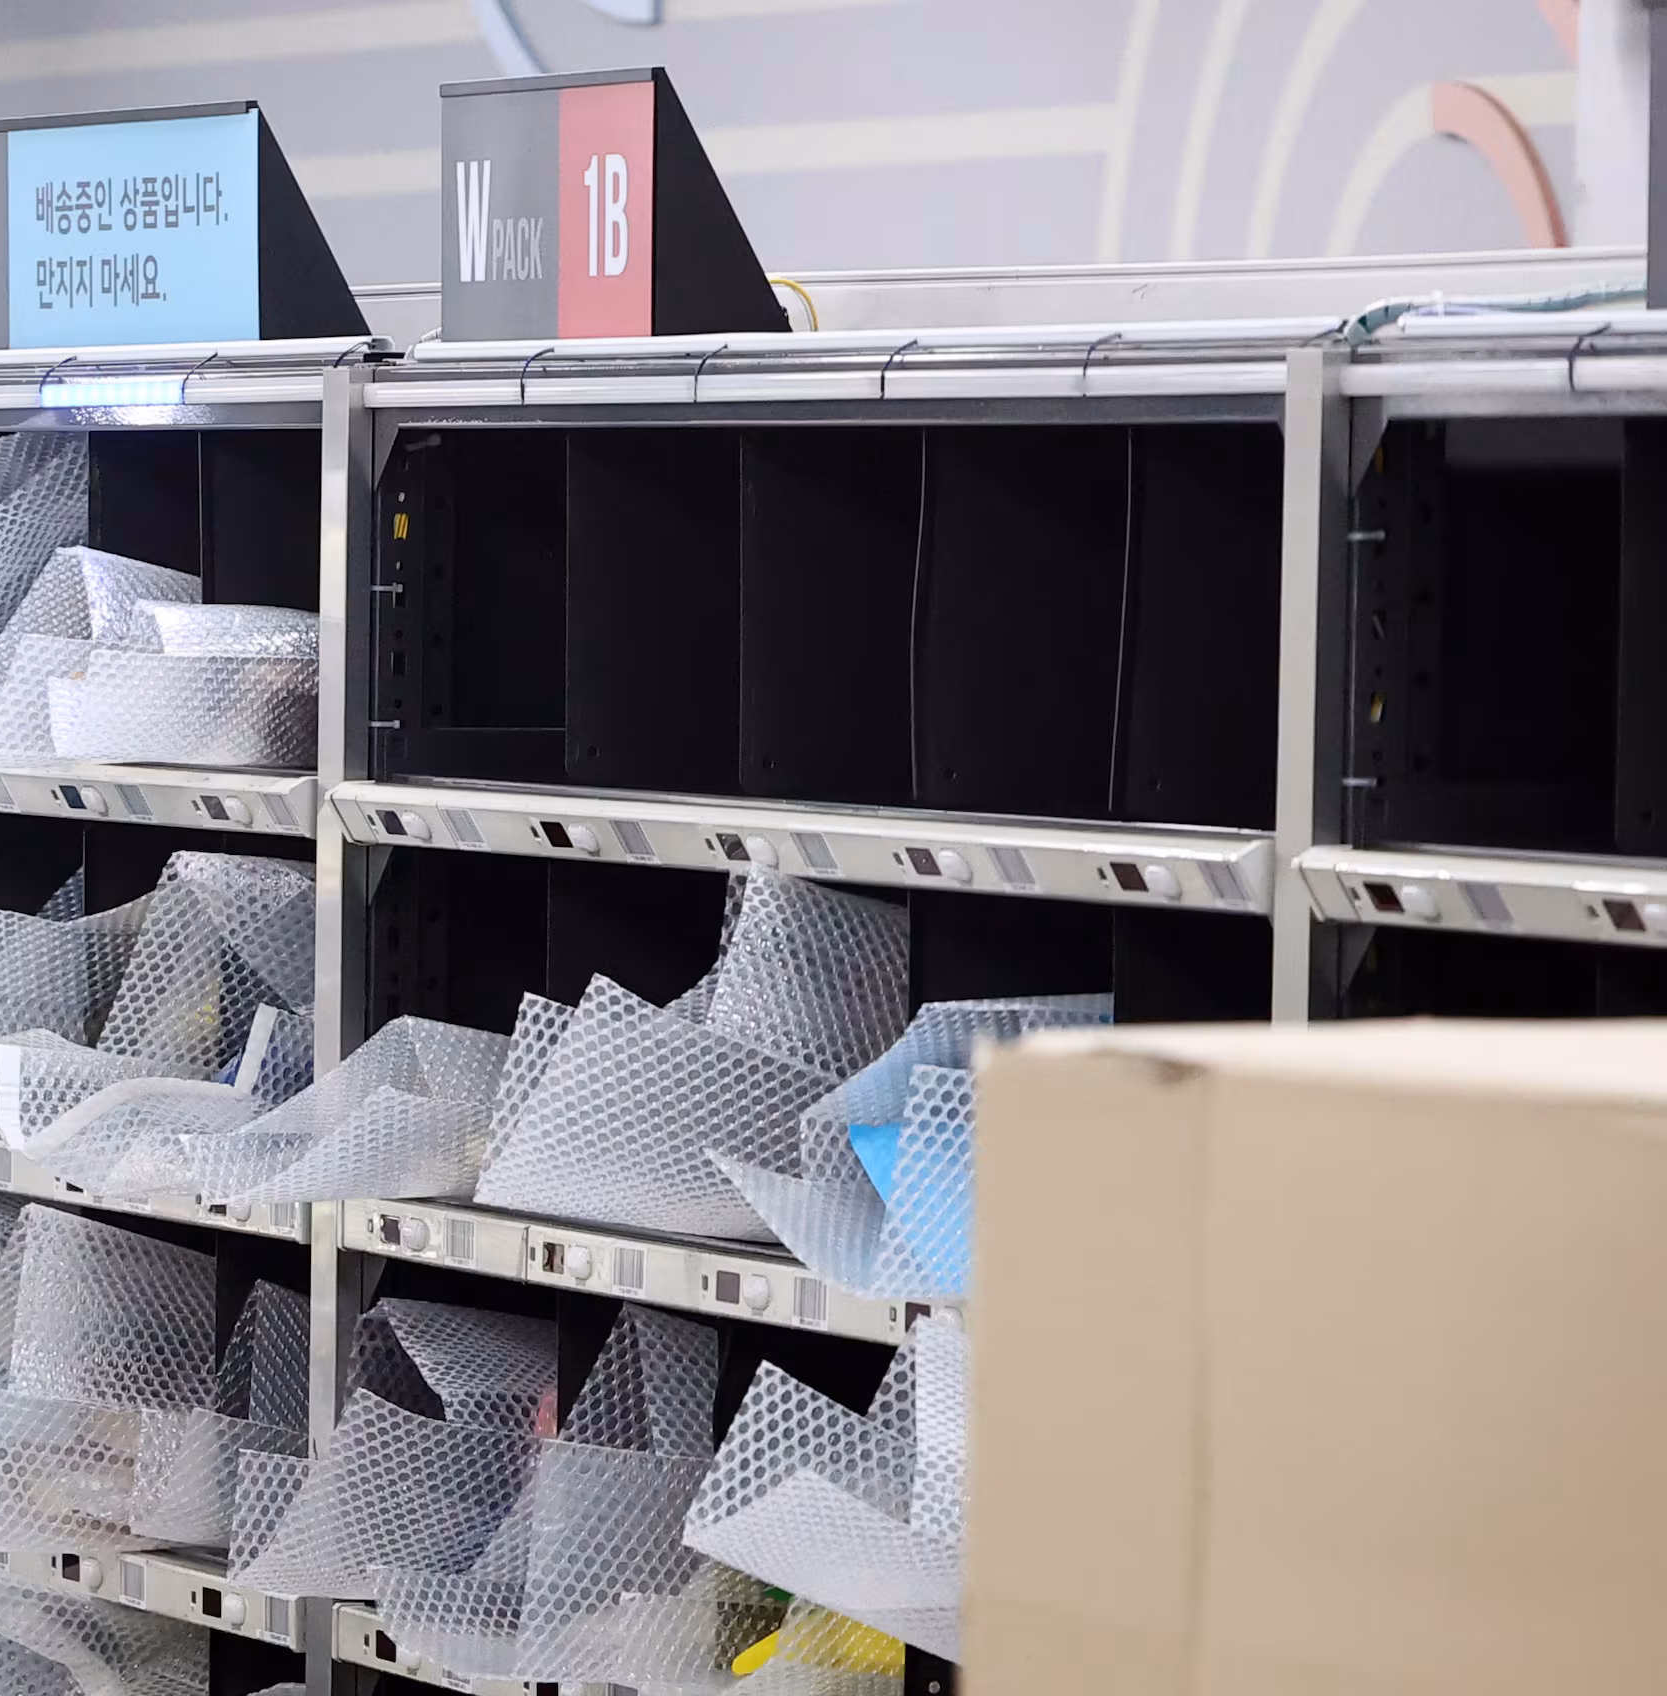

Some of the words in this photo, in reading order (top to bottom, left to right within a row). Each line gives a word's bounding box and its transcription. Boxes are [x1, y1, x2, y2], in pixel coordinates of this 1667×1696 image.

[35, 177, 113, 235] 배송중인
[119, 171, 228, 232] 상품입니다.
[583, 153, 629, 277] 1B
[36, 255, 94, 309] 만지지
[100, 253, 167, 307] 마세요.
